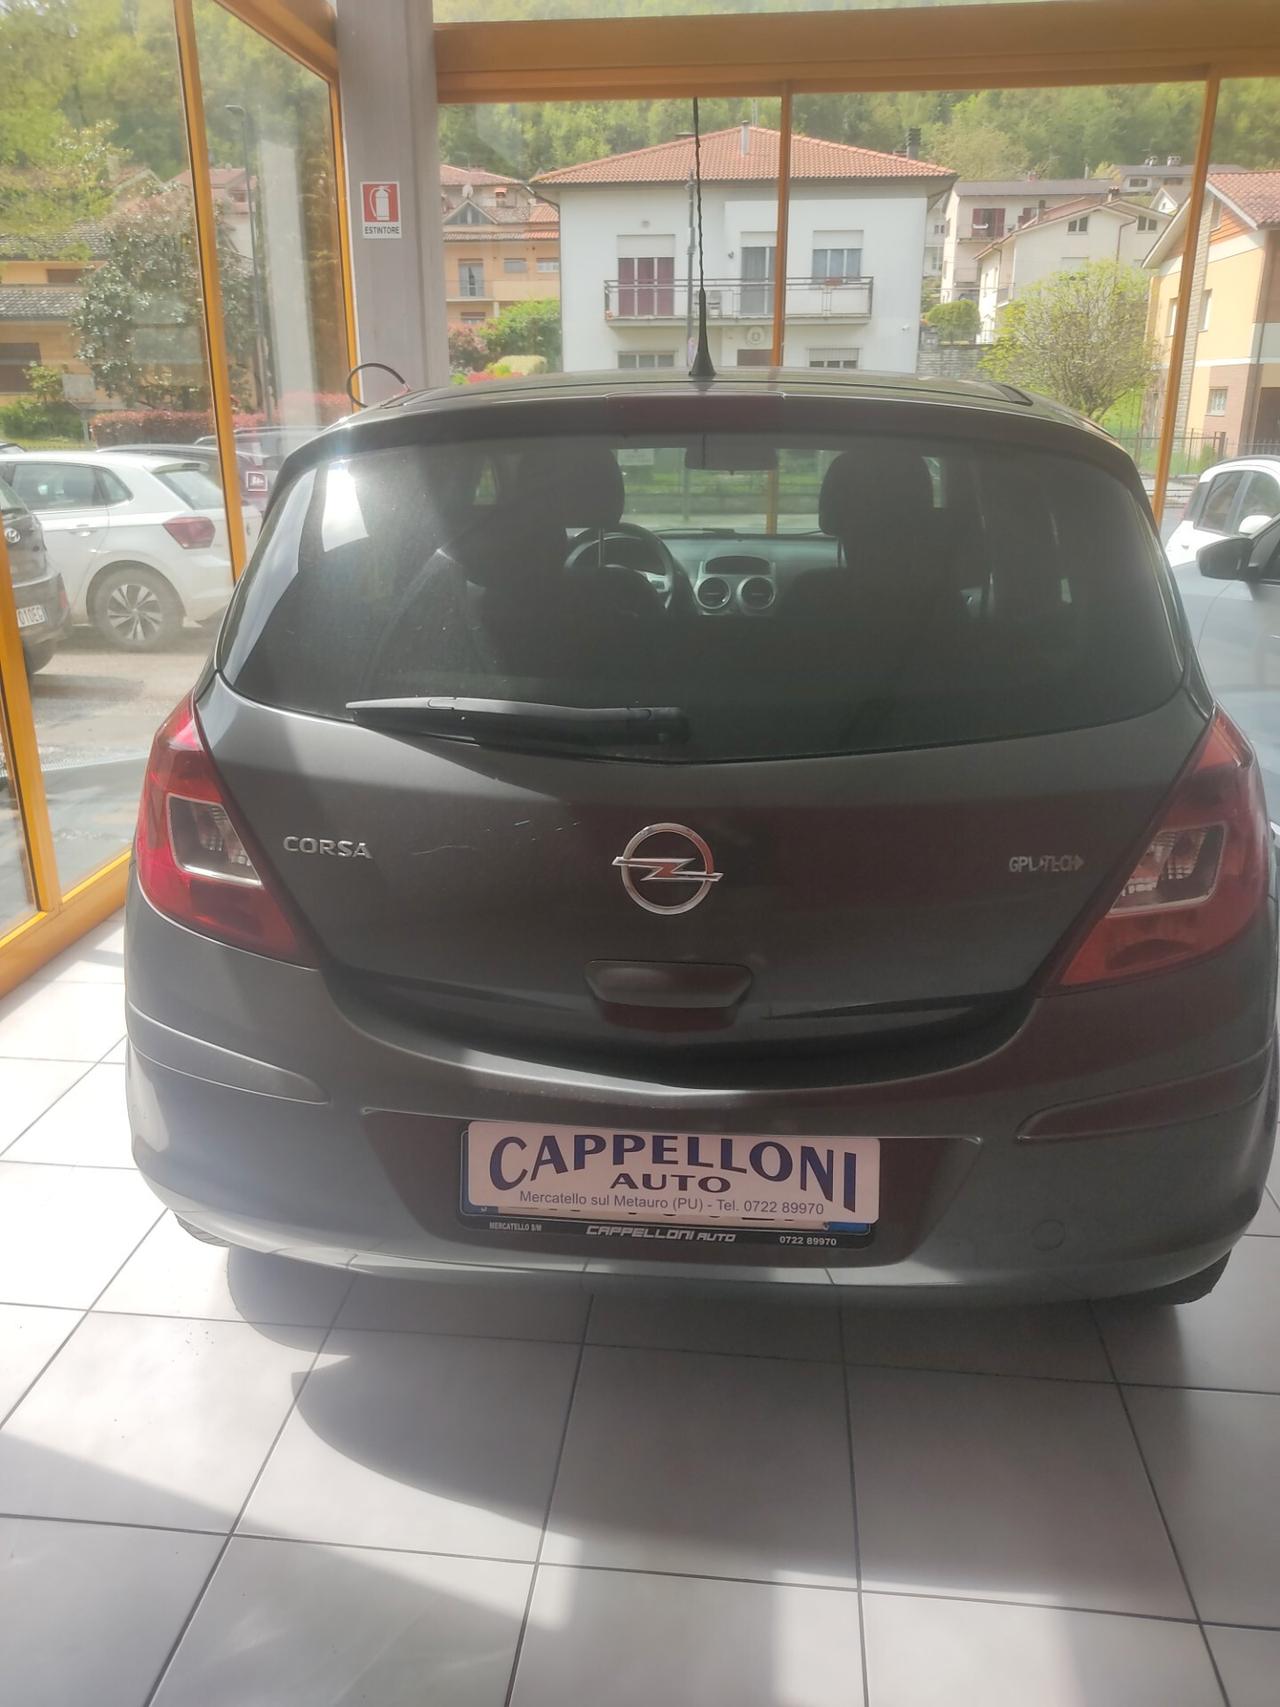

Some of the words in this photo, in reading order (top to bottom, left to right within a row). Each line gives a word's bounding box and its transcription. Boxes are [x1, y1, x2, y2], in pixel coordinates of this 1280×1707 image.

[364, 226, 400, 235] ESTINTORE
[282, 835, 373, 859] CORSA
[489, 1134, 857, 1213] CAPPELLONI
[609, 1172, 731, 1193] AUTO
[519, 1190, 587, 1205] Mercatello
[591, 1194, 610, 1206] sul
[614, 1195, 668, 1209] Metauro
[672, 1197, 703, 1212] (PU)
[717, 1198, 740, 1212] Tel.
[743, 1200, 778, 1213] 0722
[781, 1202, 824, 1215] 89970
[489, 1221, 530, 1231] MERCATELLO
[585, 1224, 694, 1241] CAPPELLONI
[695, 1231, 737, 1243] AUTO
[779, 1235, 804, 1245] 0722
[806, 1236, 837, 1247] 89970
